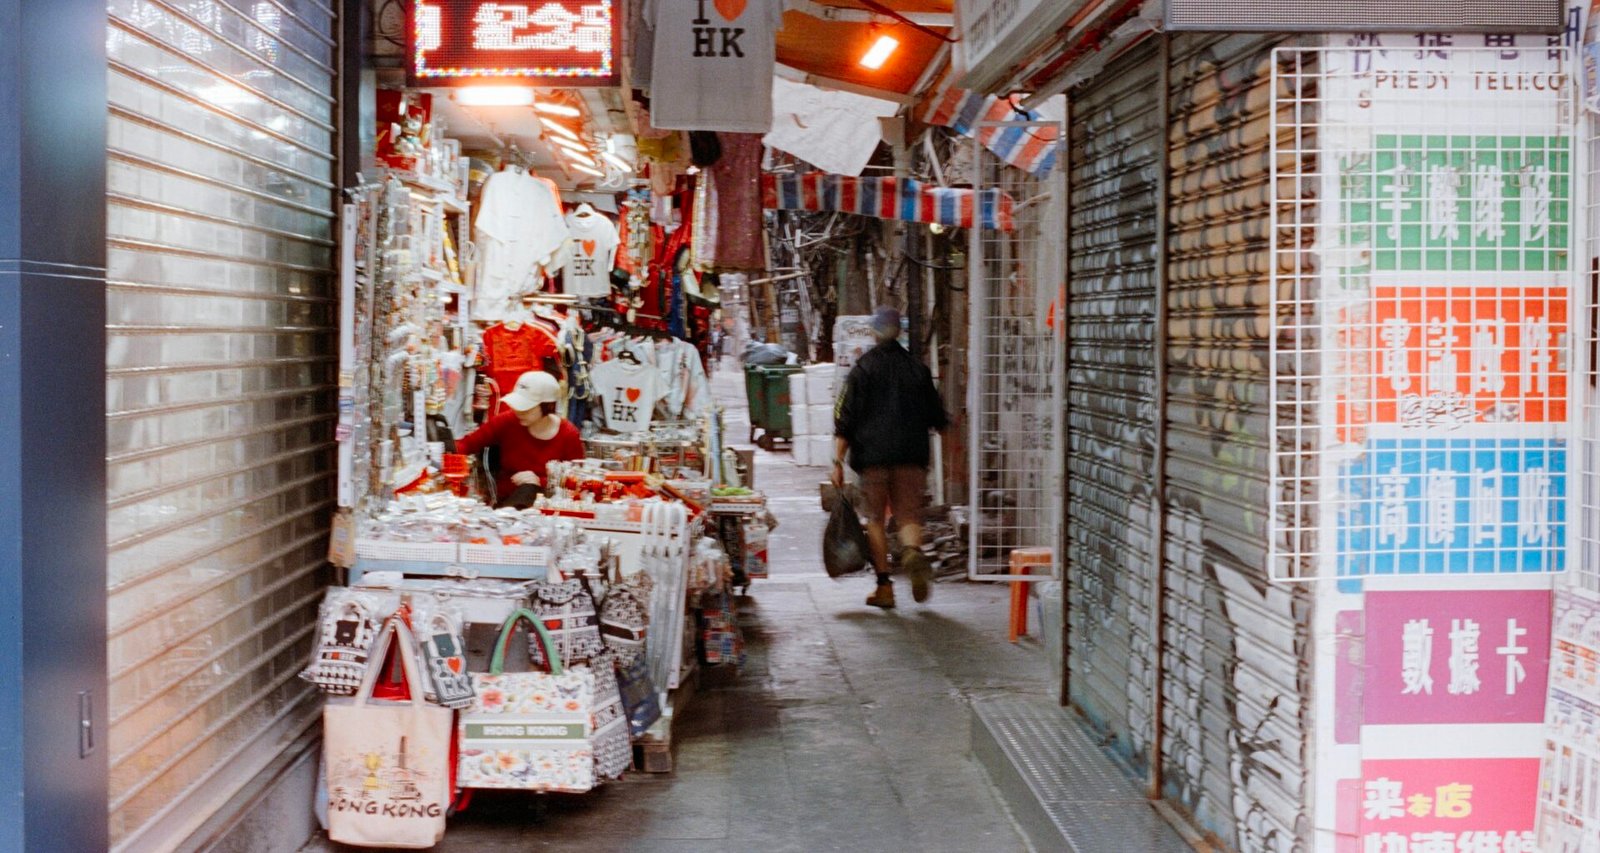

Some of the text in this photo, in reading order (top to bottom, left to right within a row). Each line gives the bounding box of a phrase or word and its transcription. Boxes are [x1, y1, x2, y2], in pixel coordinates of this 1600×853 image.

[692, 0, 710, 25] I
[692, 27, 745, 58] HK
[573, 238, 582, 257] I
[573, 259, 596, 276] HK
[614, 386, 624, 404] I
[612, 404, 638, 423] HK
[1400, 618, 1529, 696] 數據卡
[482, 724, 569, 737] HONG KONG
[382, 802, 442, 818] KONG
